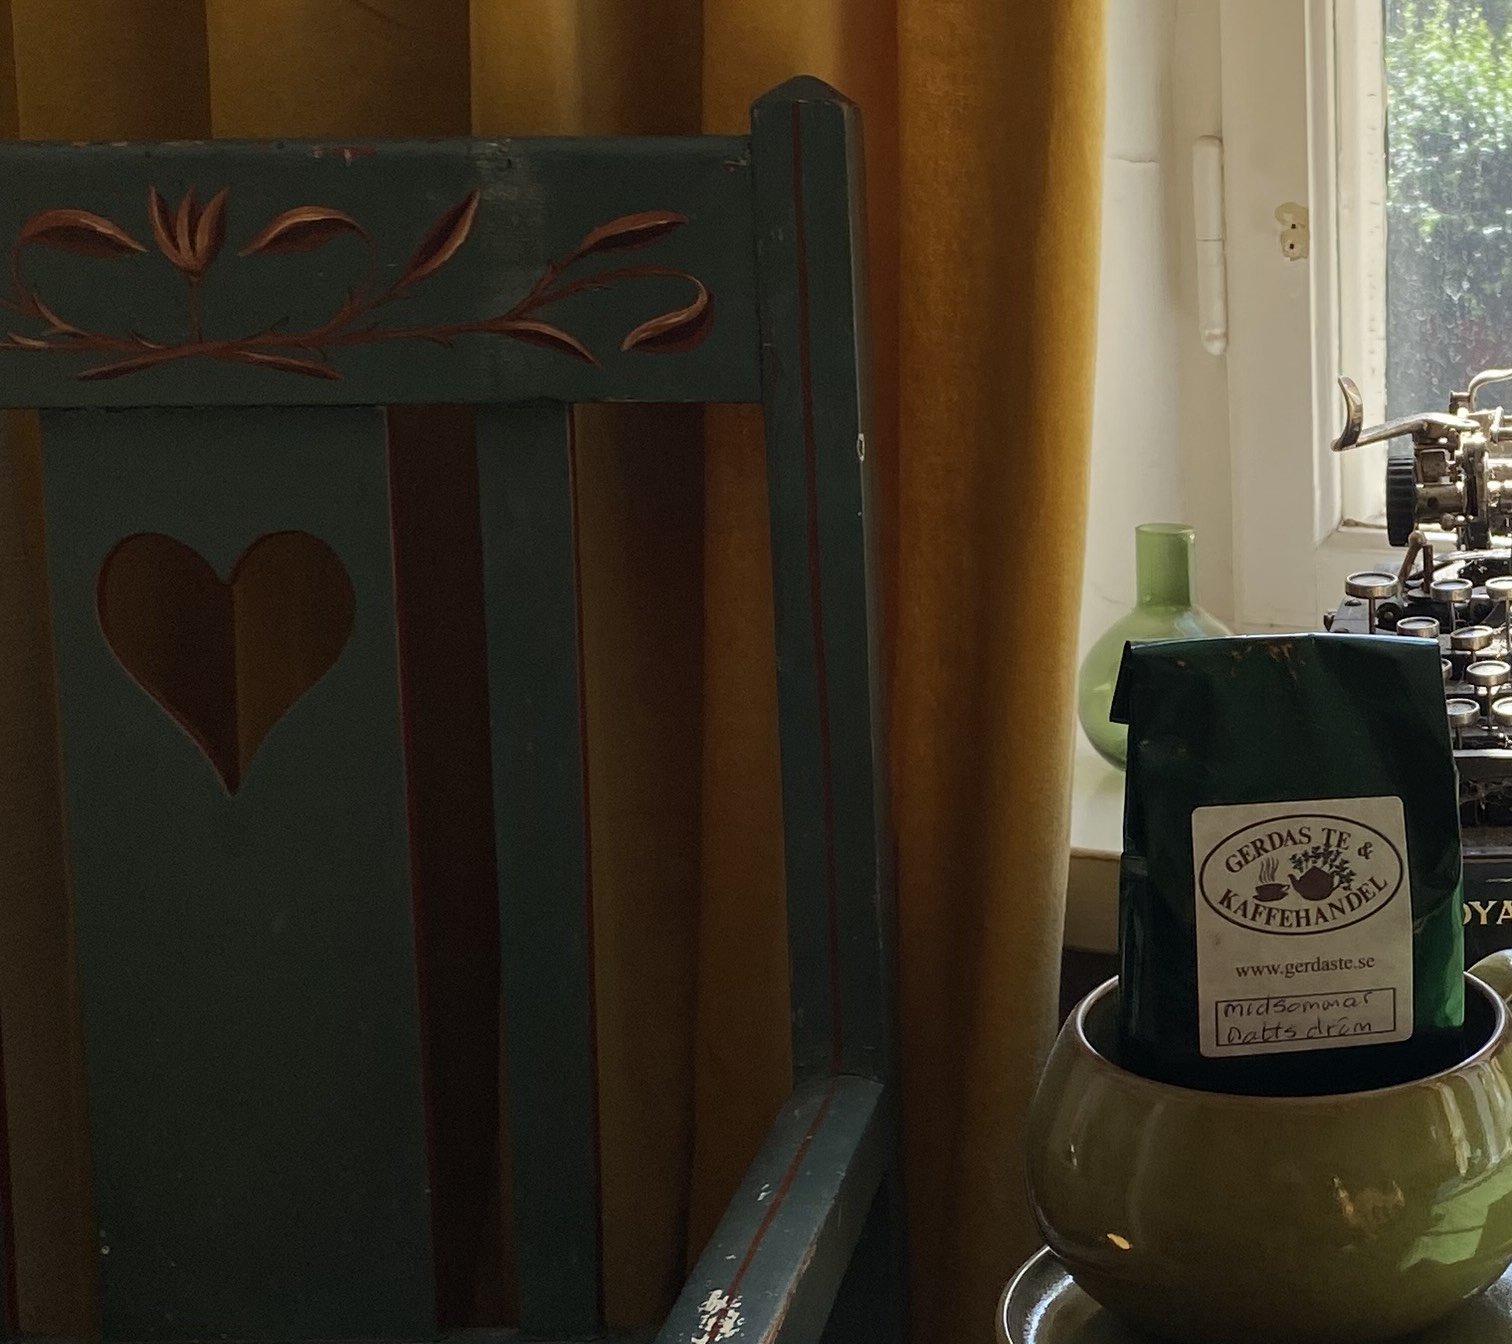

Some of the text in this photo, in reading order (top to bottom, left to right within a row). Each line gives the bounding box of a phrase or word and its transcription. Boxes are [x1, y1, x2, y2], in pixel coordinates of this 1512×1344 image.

[1225, 826, 1374, 873] GERDAS TE &
[1218, 875, 1388, 928] KAFFEHANDEL
[1235, 956, 1376, 978] www.gerdaste.se
